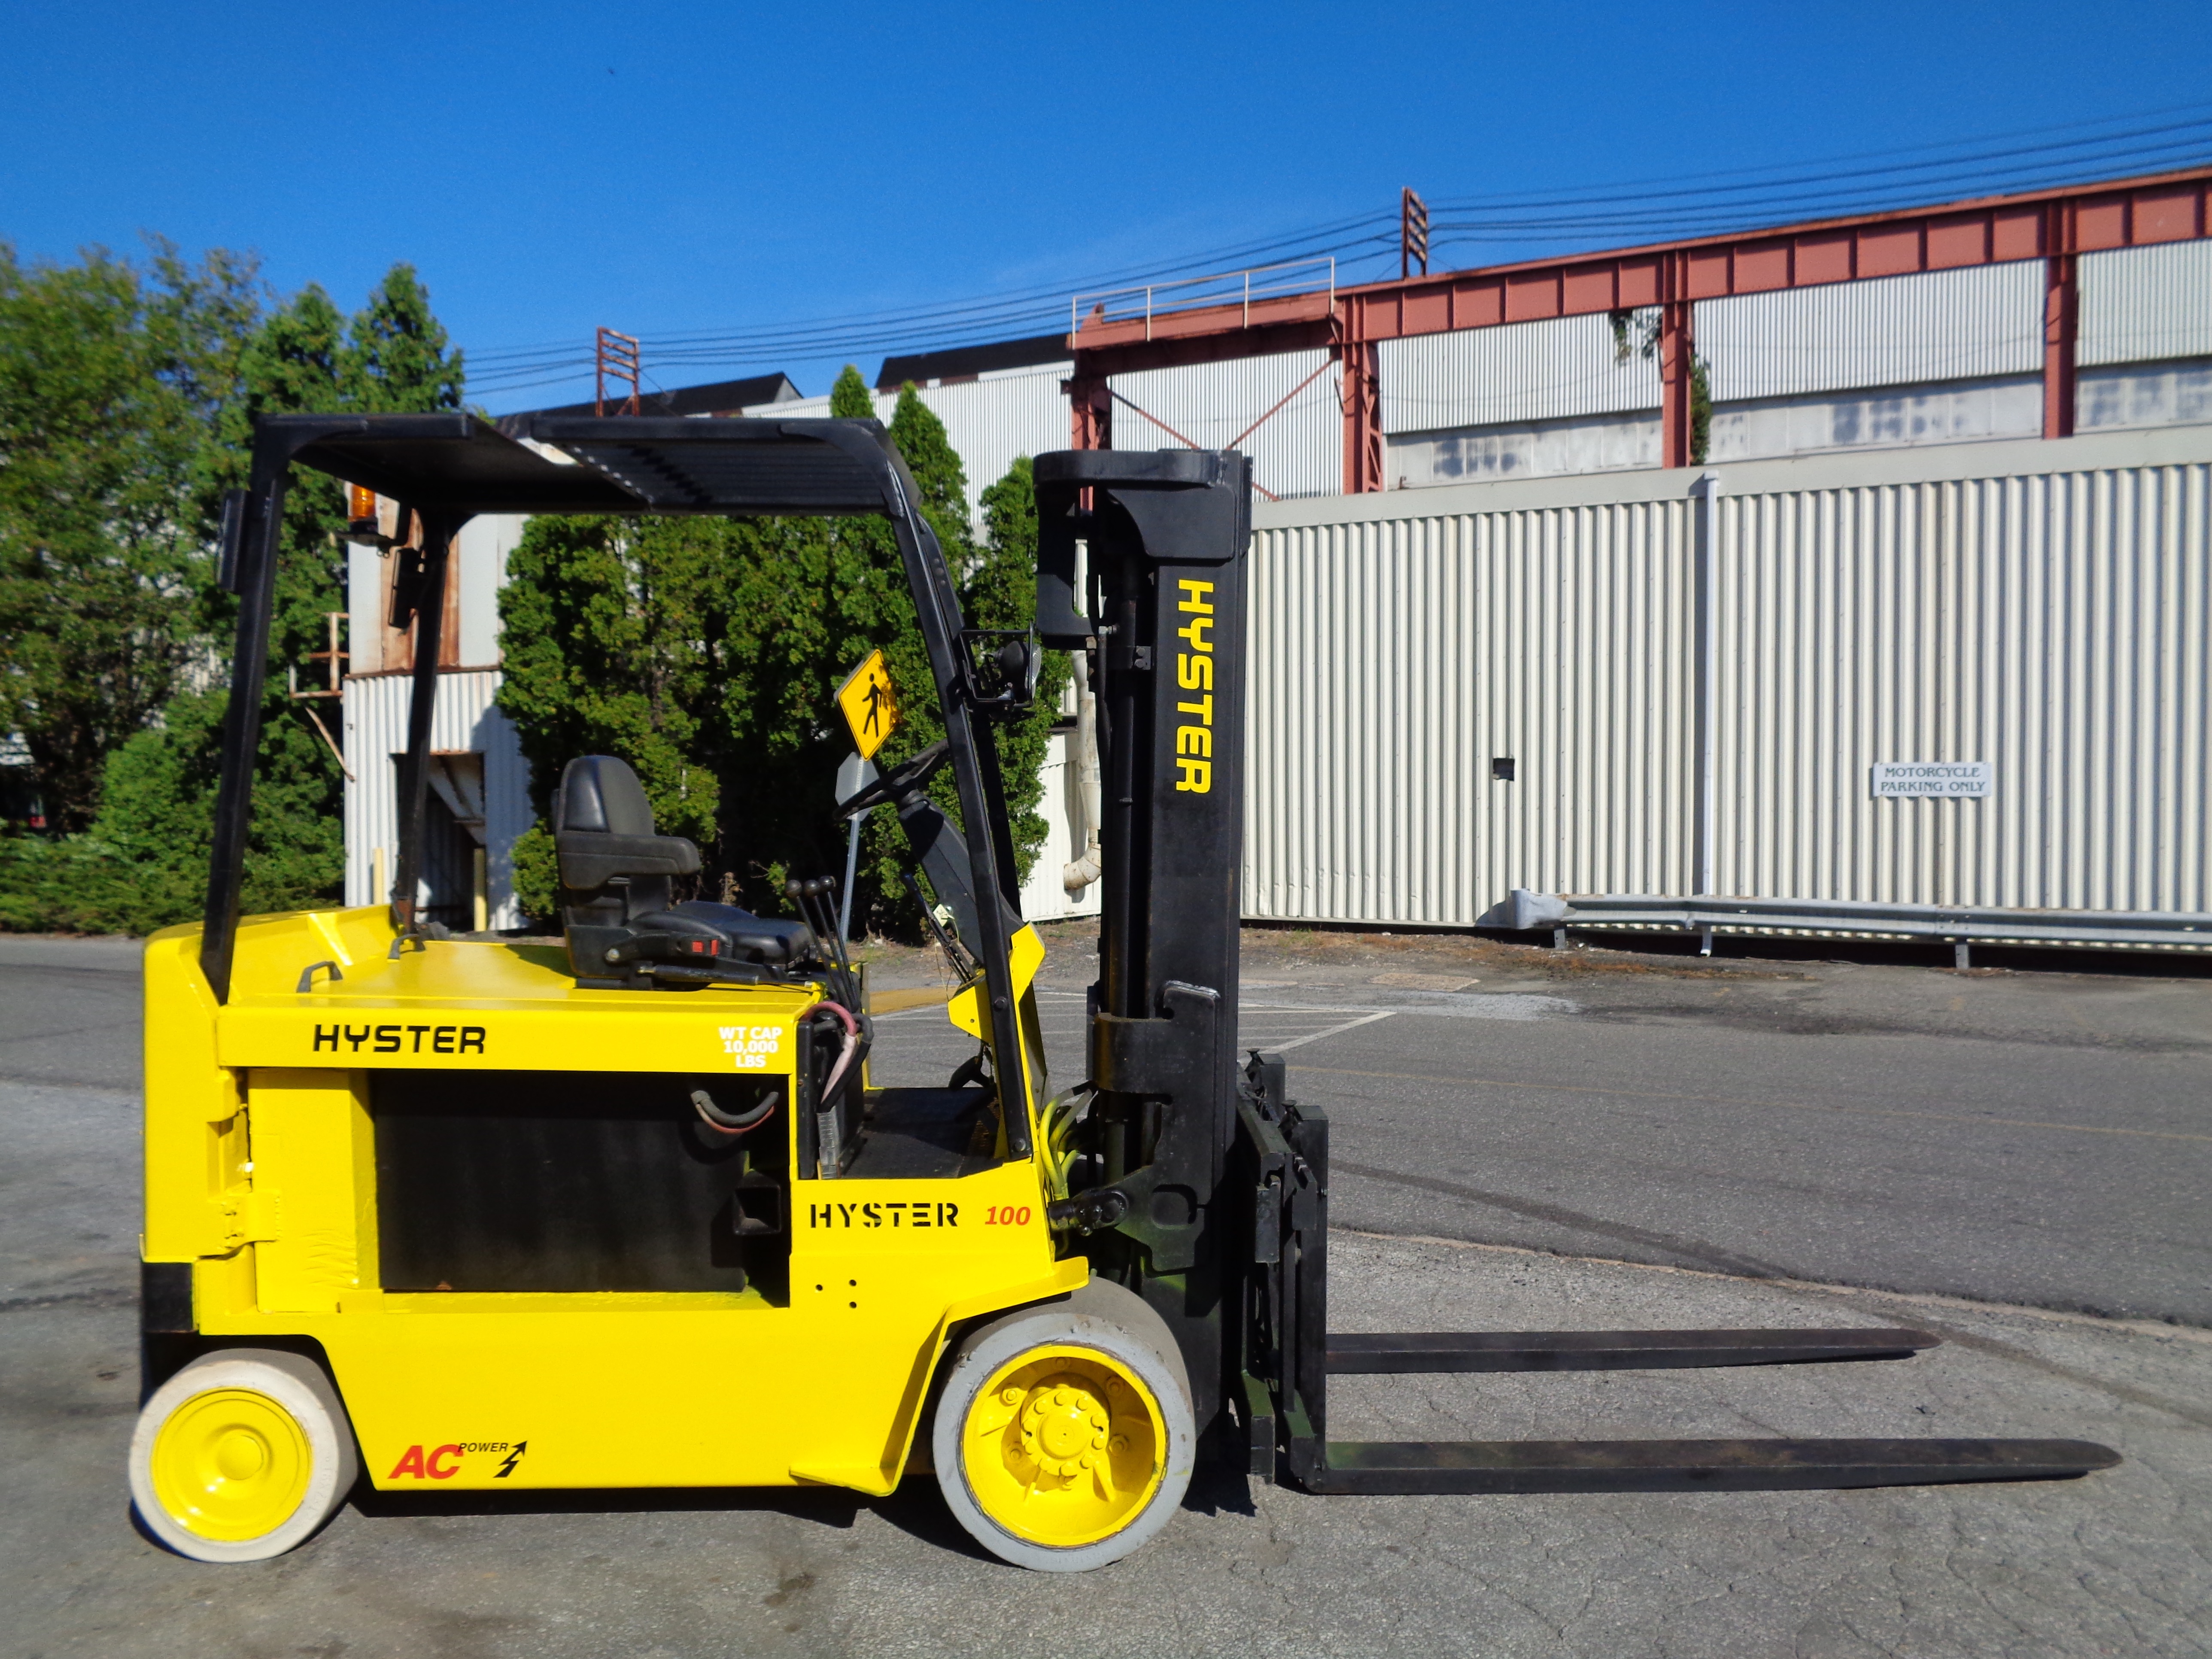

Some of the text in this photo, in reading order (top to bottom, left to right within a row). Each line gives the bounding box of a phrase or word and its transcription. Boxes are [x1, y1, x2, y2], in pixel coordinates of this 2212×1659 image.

[1176, 579, 1214, 794] HYSTER
[1884, 767, 1981, 778] MOTORCYCLE
[1881, 781, 1985, 792] PARKING ONLY
[313, 1024, 486, 1054] HYSTER
[719, 1027, 782, 1040] WT CAP
[724, 1040, 778, 1055] 10,000
[735, 1054, 766, 1068] LBS
[810, 1203, 1031, 1228] HYSTER 100
[387, 1442, 508, 1480] AC POWER
